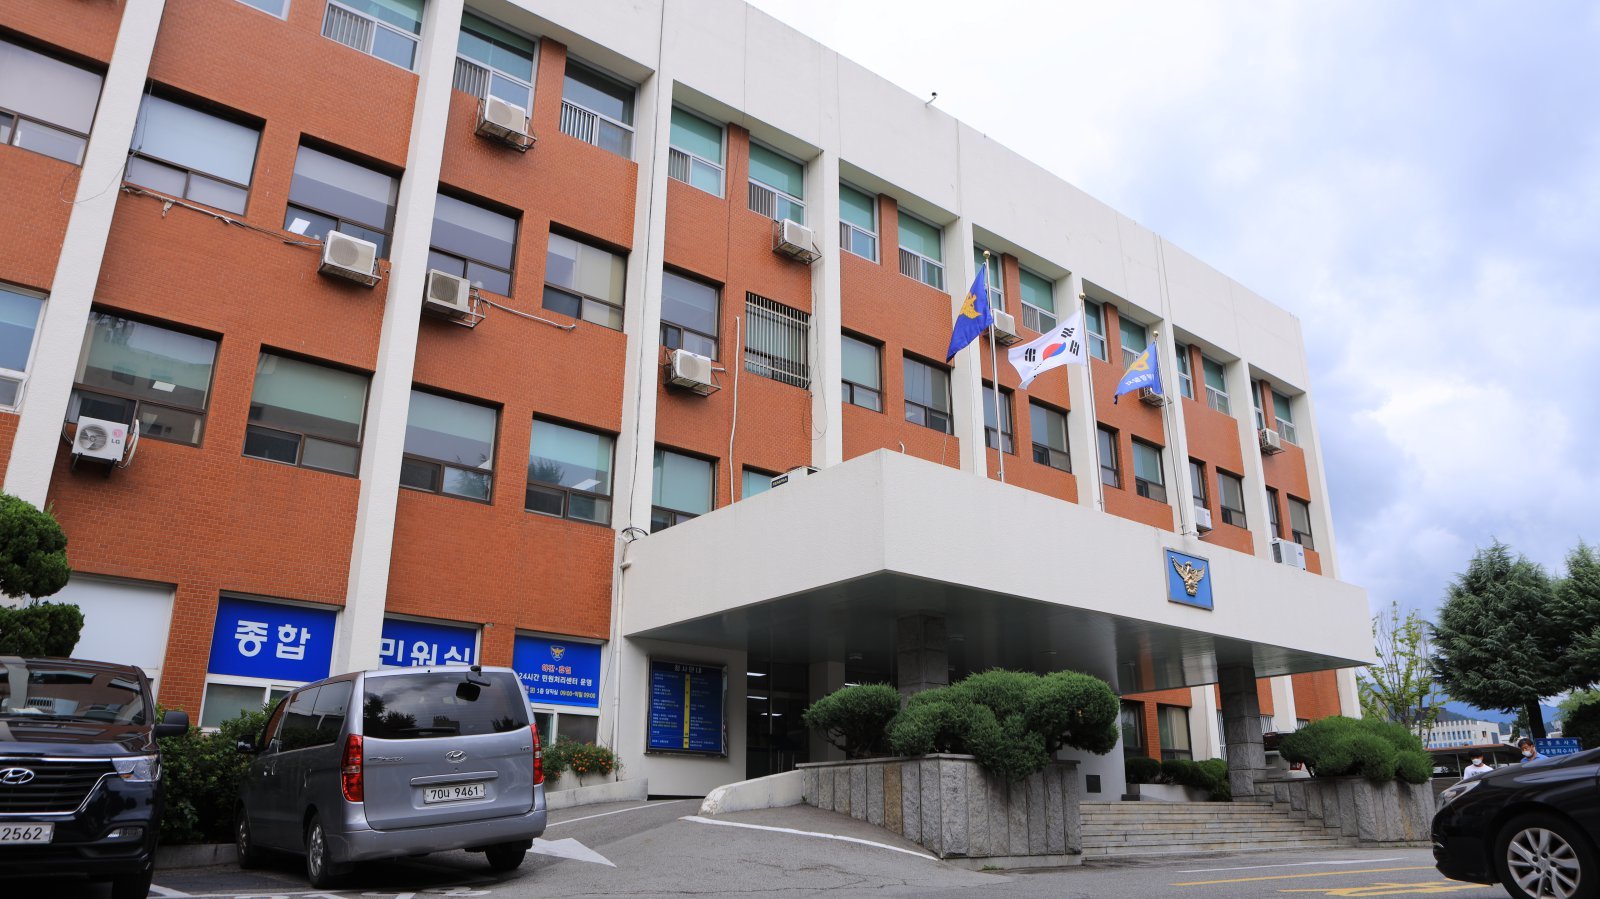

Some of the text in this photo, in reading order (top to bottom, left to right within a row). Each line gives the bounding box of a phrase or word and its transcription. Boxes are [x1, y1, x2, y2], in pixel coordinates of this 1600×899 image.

[234, 619, 311, 661] 종합
[518, 672, 540, 682] 24시간
[541, 674, 578, 686] 민원처리센터
[454, 786, 479, 798] 9461
[2, 827, 43, 841] 2562
